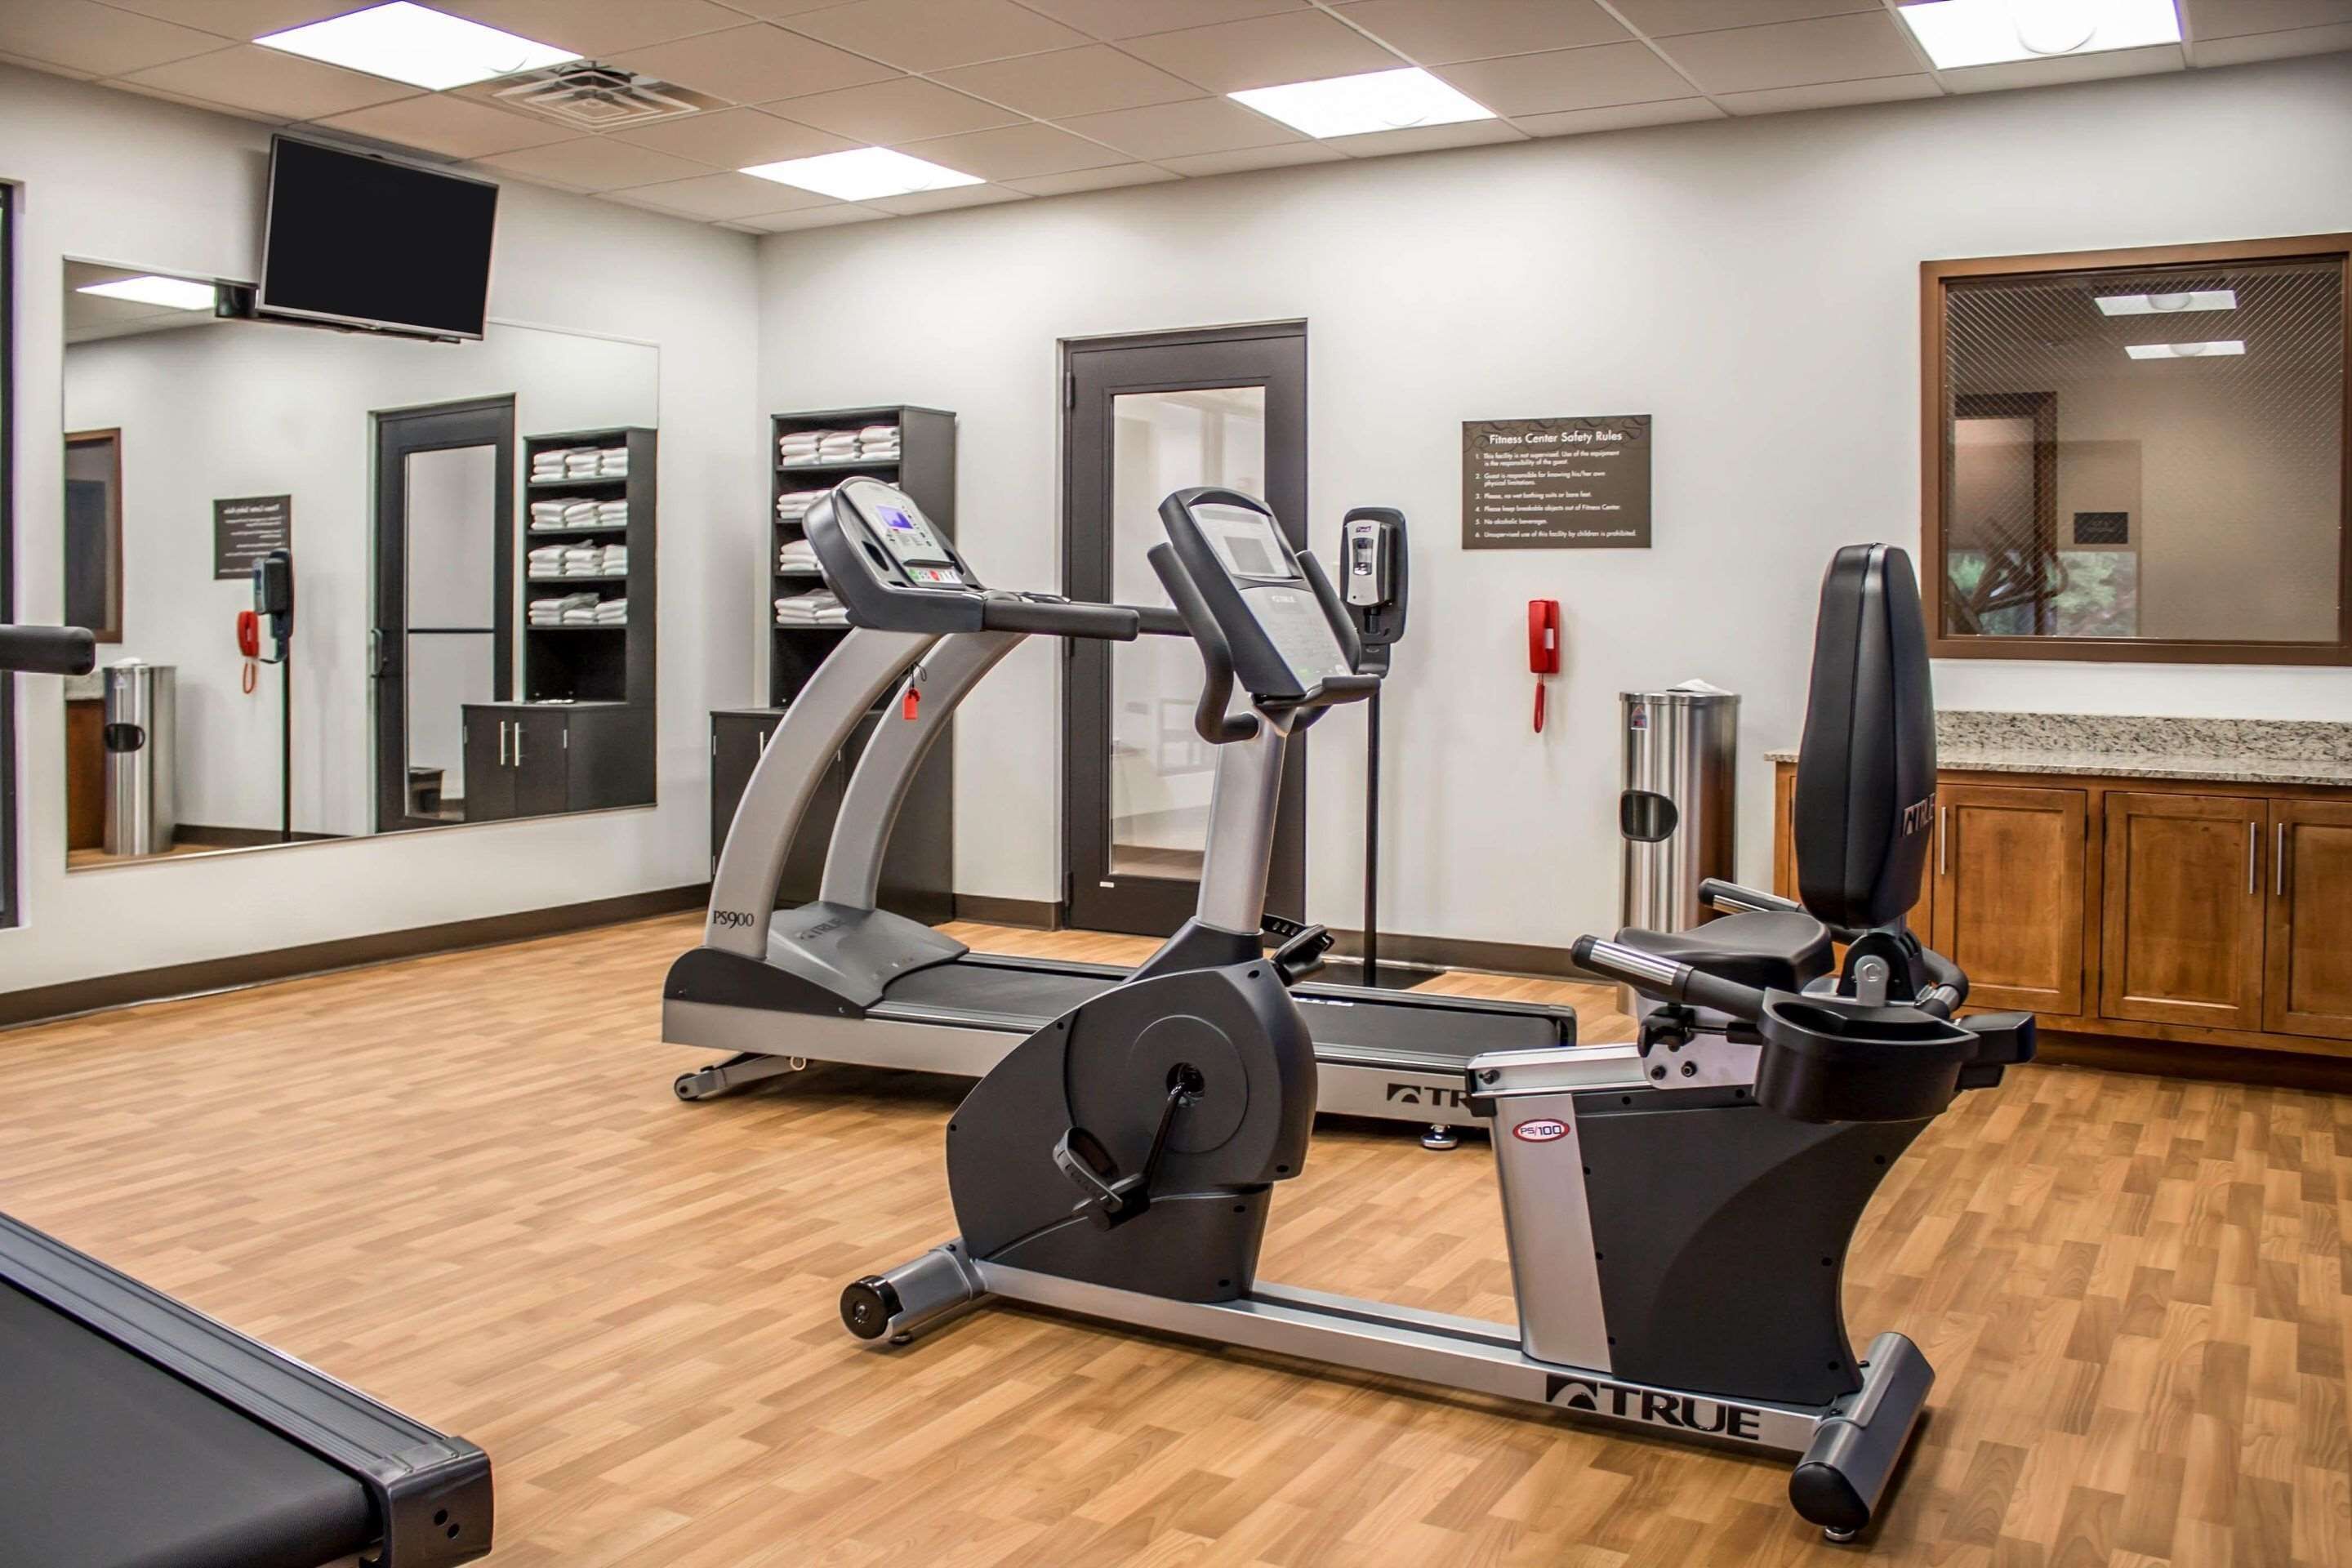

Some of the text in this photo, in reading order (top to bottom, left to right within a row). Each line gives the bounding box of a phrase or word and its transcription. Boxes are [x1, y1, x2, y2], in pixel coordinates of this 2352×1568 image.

[1489, 429, 1623, 444] Fitness Center Safety Rules
[1494, 452, 1513, 460] facility
[1548, 529, 1567, 538] facility
[1568, 529, 1575, 538] by
[712, 910, 755, 929] PS900
[1423, 1086, 1471, 1108] TR
[1520, 1125, 1562, 1136] PS/100
[1598, 1383, 1761, 1441] TRUE
